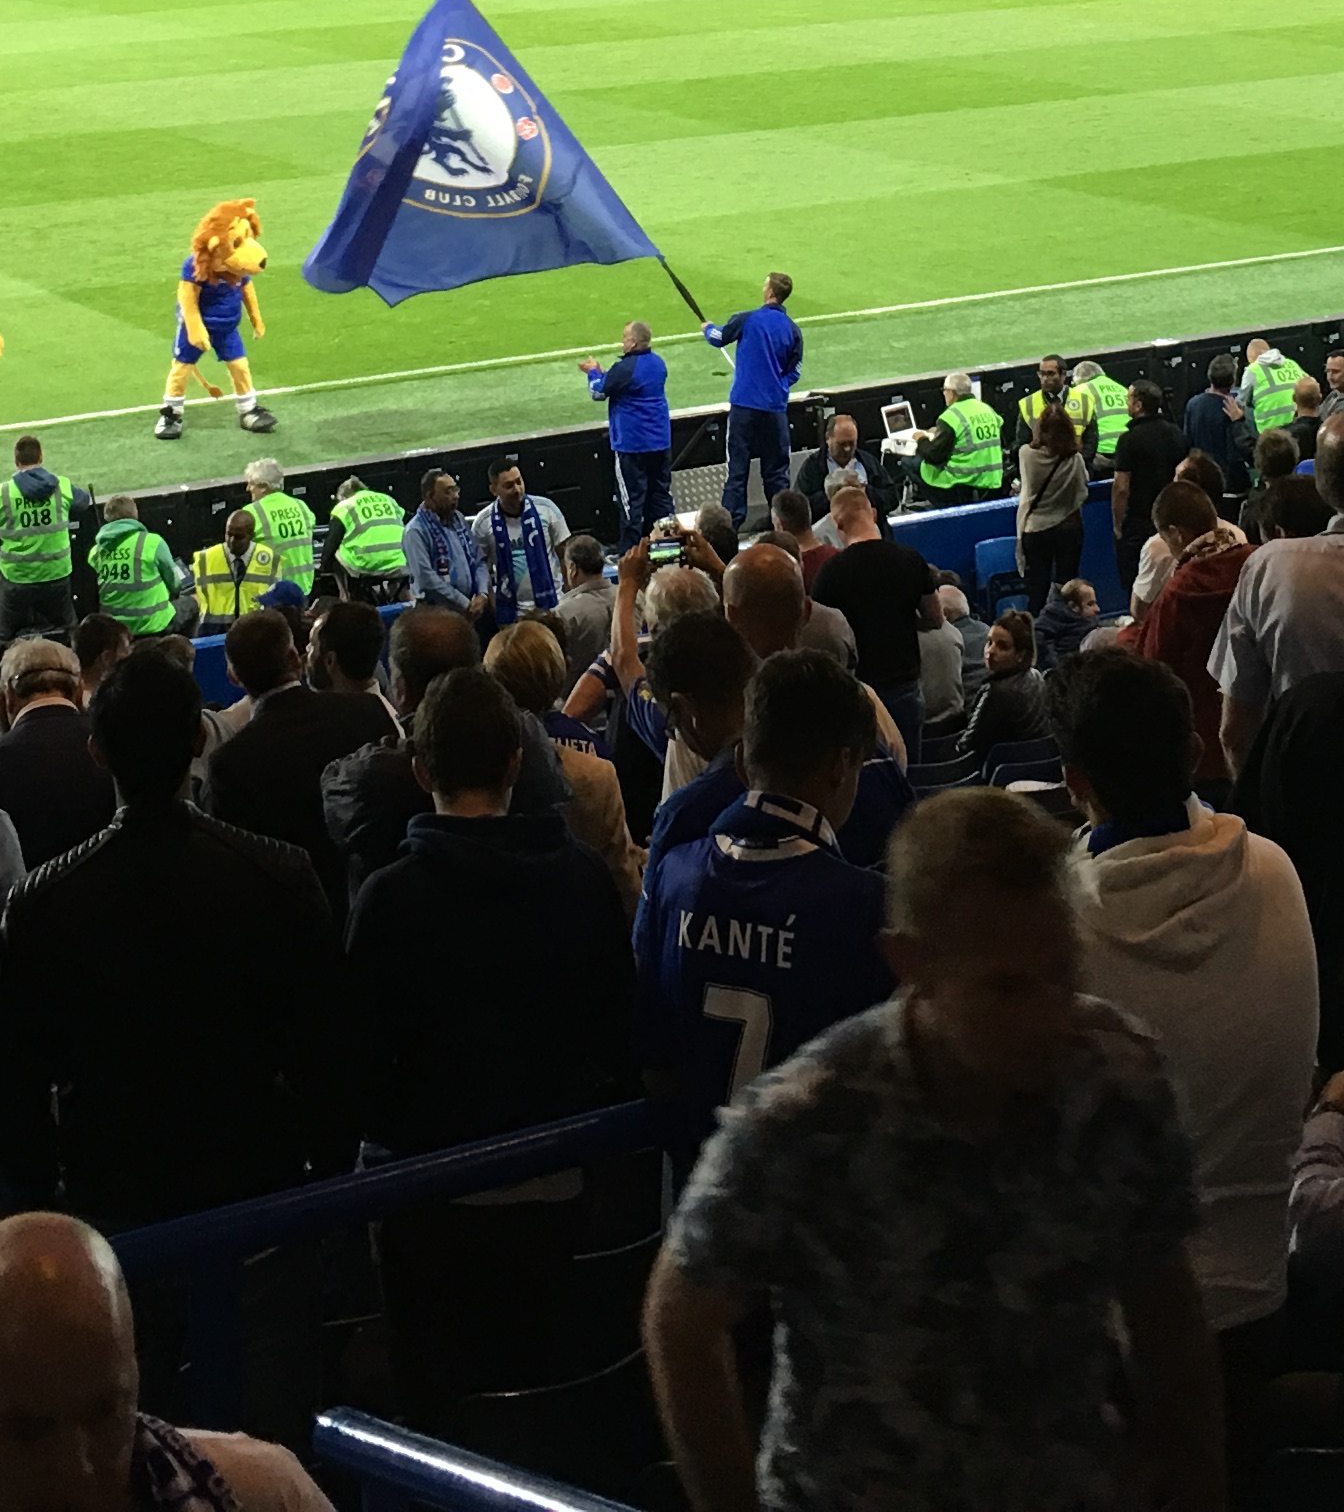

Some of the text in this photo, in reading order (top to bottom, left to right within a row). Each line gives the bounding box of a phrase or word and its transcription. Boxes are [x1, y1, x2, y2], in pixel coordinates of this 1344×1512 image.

[970, 412, 994, 426] PRESS
[976, 424, 997, 440] 032
[356, 495, 389, 506] PRESS
[20, 509, 52, 528] 018
[270, 507, 301, 523] PRESS
[361, 504, 393, 520] 058
[278, 519, 305, 539] 012
[101, 563, 131, 581] 048
[678, 909, 797, 970] KANTÉ
[703, 982, 773, 1106] 7
